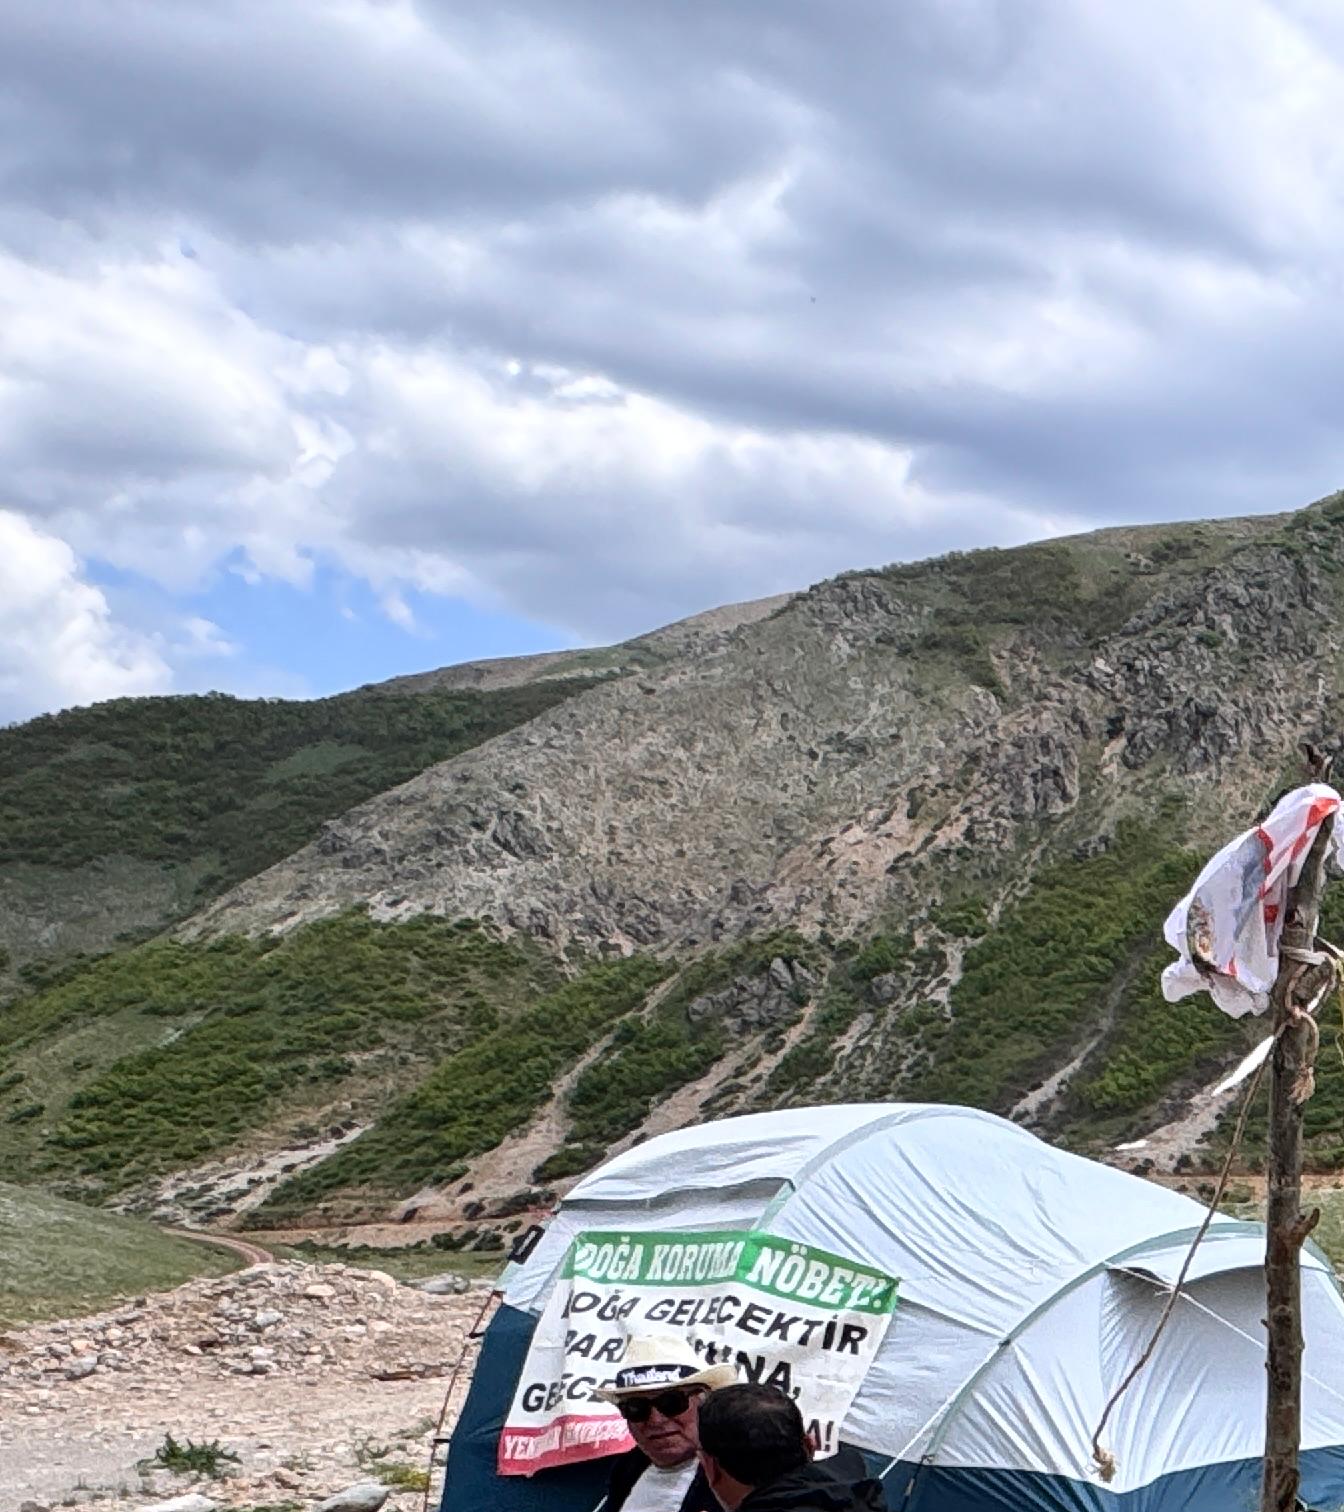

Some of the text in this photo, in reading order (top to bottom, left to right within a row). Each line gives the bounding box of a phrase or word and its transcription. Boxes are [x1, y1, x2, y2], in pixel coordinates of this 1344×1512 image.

[574, 1236, 643, 1281] DOĞA
[645, 1241, 745, 1281] KORUMA
[644, 1294, 868, 1355] GELECEKTİR
